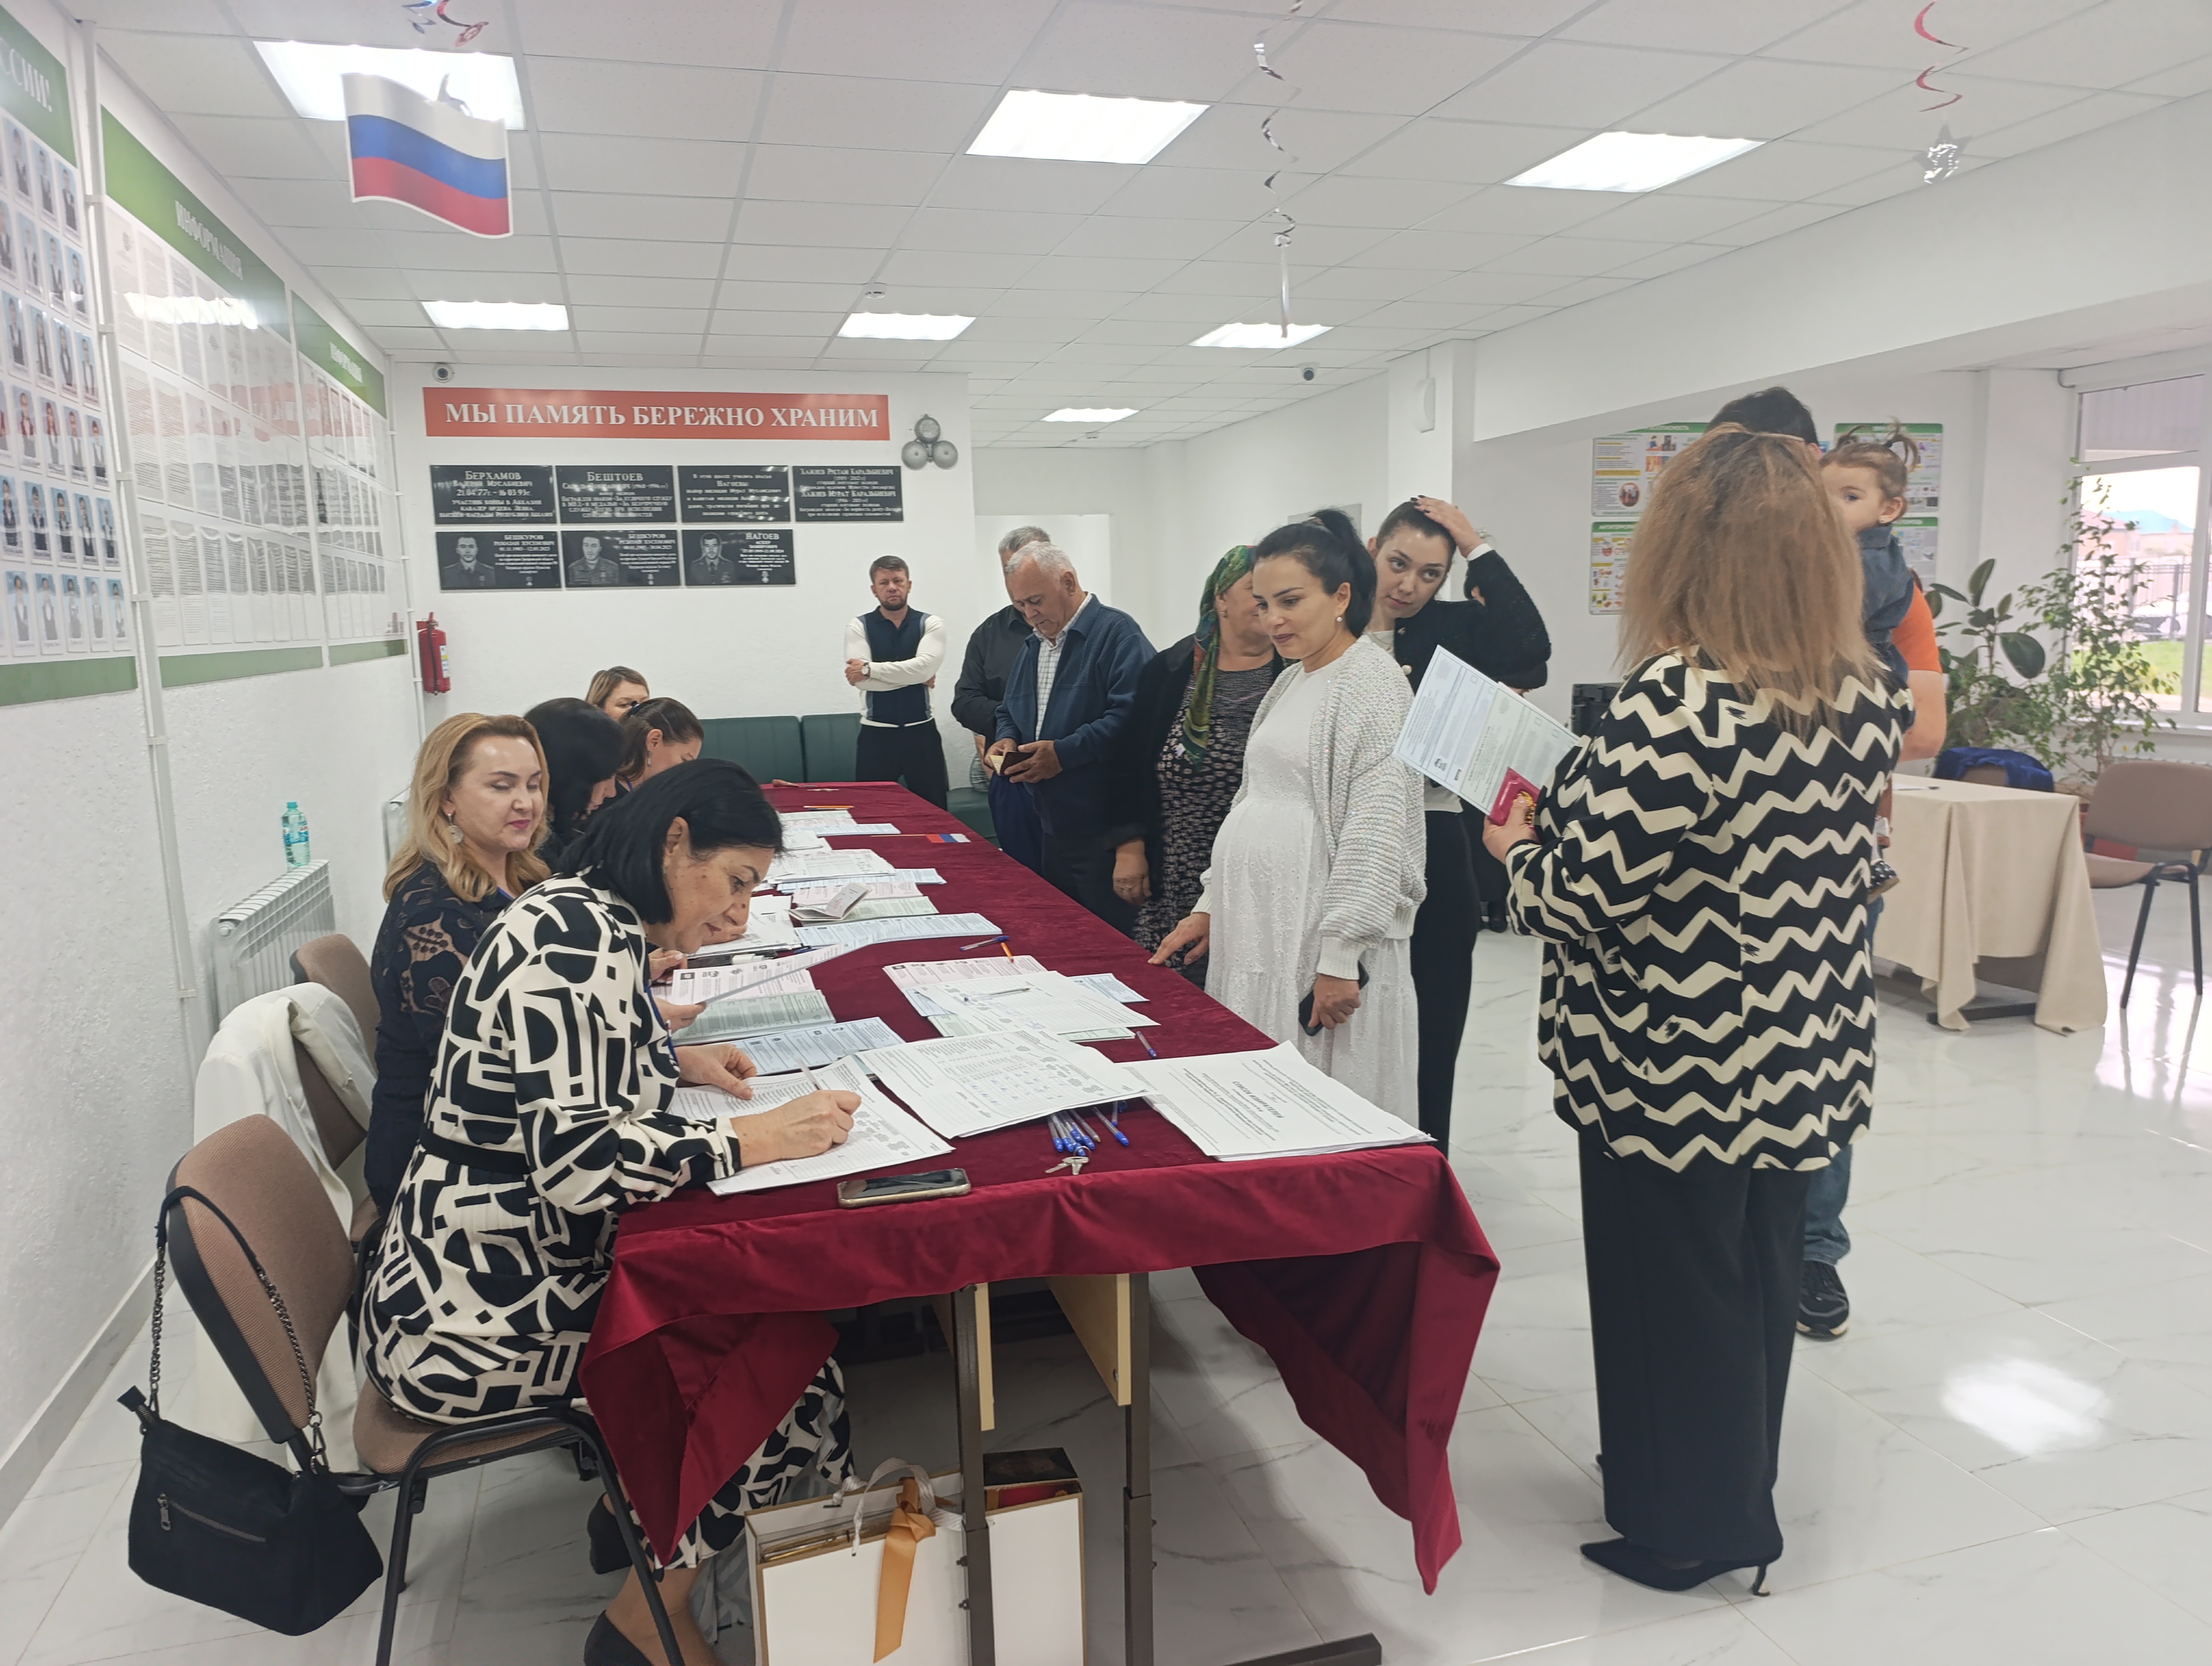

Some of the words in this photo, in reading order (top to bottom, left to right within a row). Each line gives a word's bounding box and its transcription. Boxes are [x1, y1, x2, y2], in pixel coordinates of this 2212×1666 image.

[444, 403, 498, 423] МЫ
[504, 404, 626, 425] ПАМЯТЬ
[632, 406, 764, 426] БЕРЕЖНО
[770, 408, 879, 427] ХРАНИМ
[465, 471, 522, 480] БЕРХАМОВ
[587, 471, 644, 481] БЕШТОЕВ
